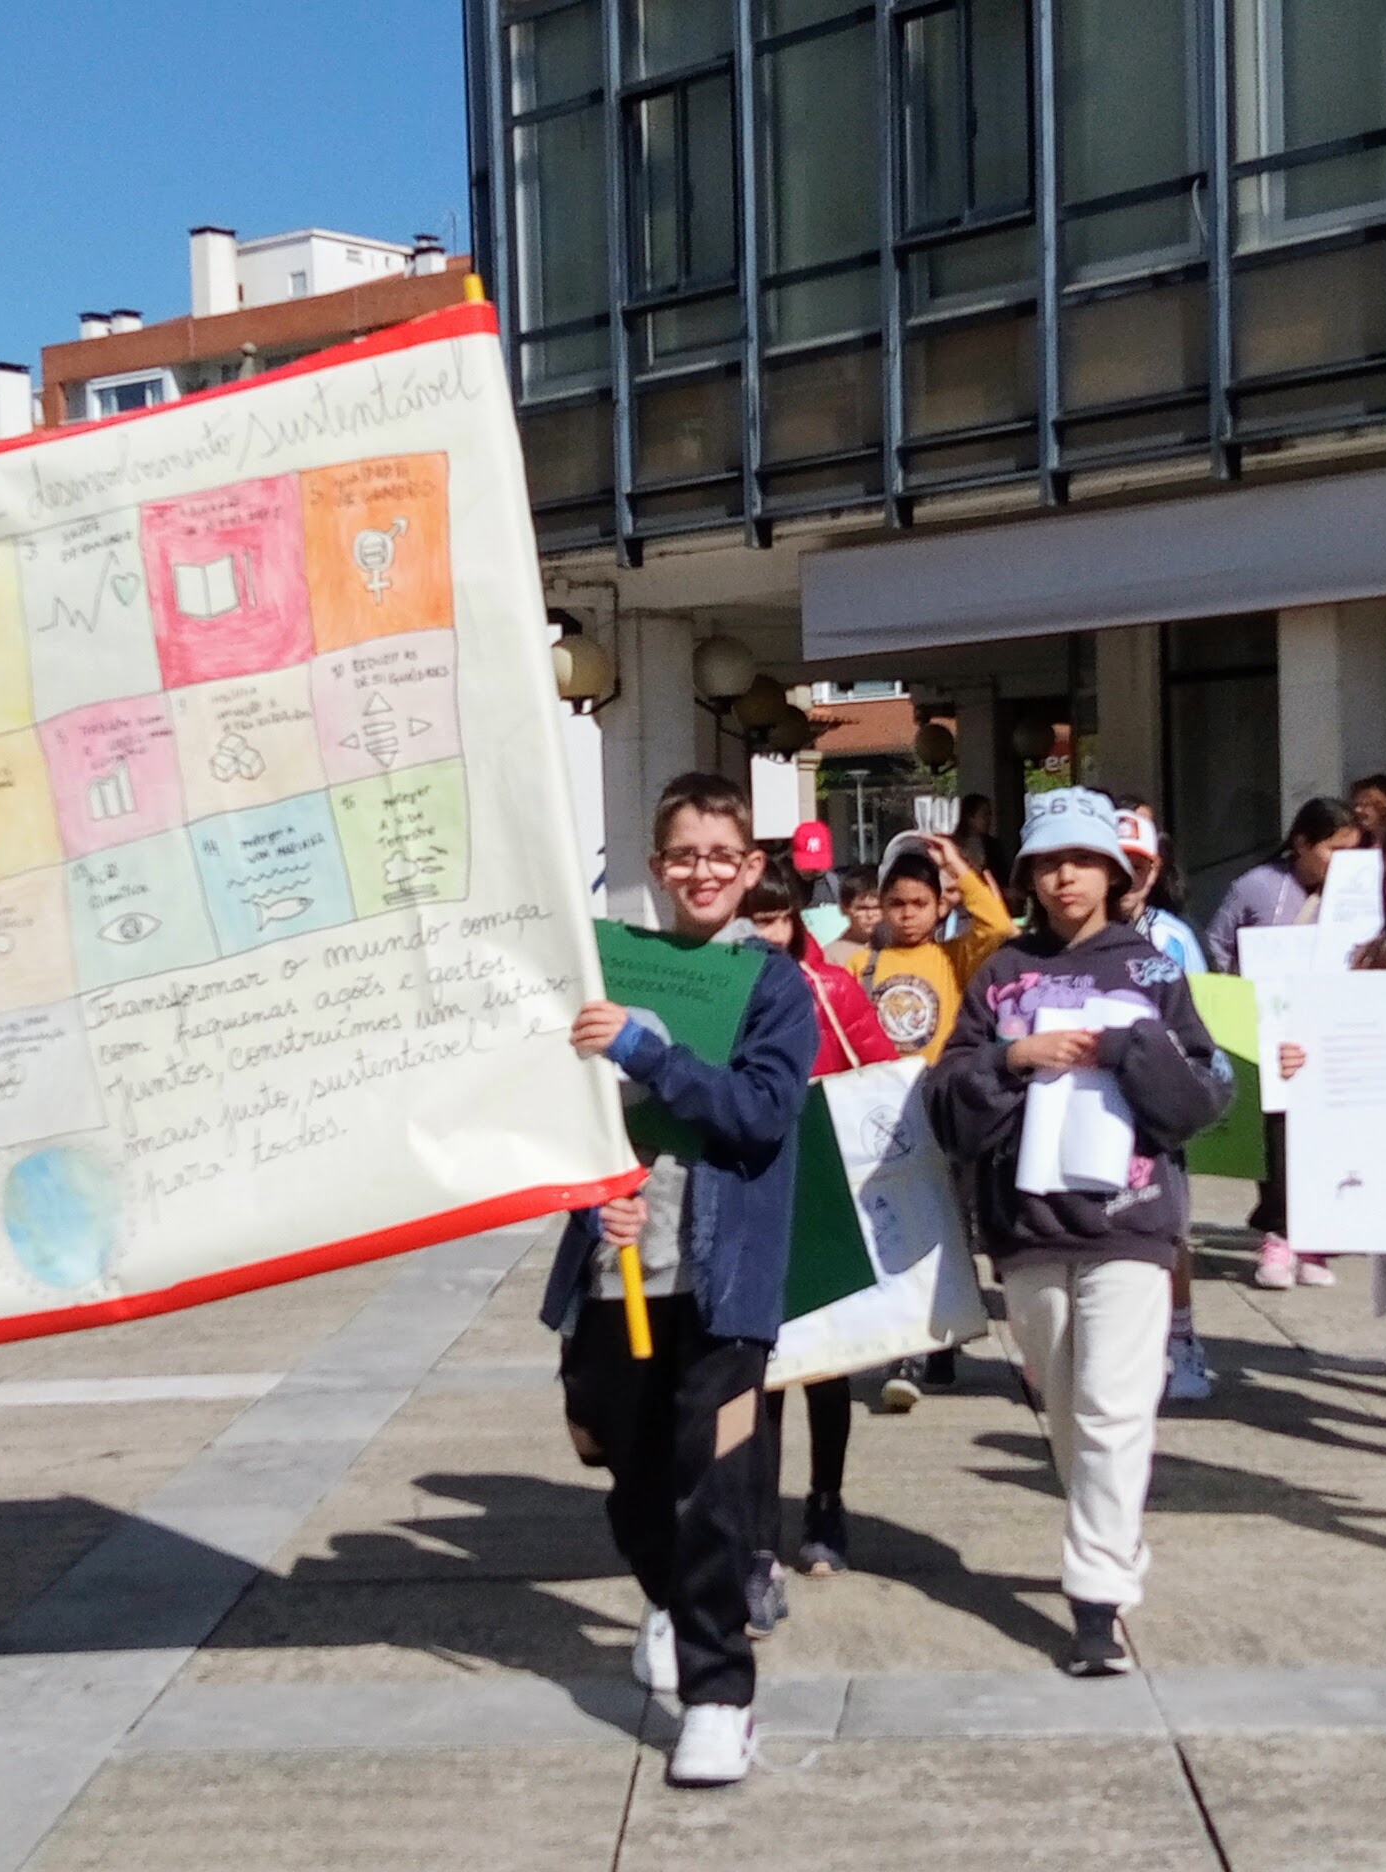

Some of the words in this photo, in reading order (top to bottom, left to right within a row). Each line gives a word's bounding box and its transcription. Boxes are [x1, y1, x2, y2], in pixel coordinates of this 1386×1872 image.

[280, 956, 310, 980] o
[322, 914, 450, 970] mundo
[98, 1036, 153, 1067] com
[173, 998, 300, 1054] pequenas
[397, 973, 417, 992] e
[228, 1012, 403, 1072] construímos
[121, 1115, 211, 1160] mais
[309, 1016, 501, 1107] sustentável
[141, 1160, 226, 1213] para
